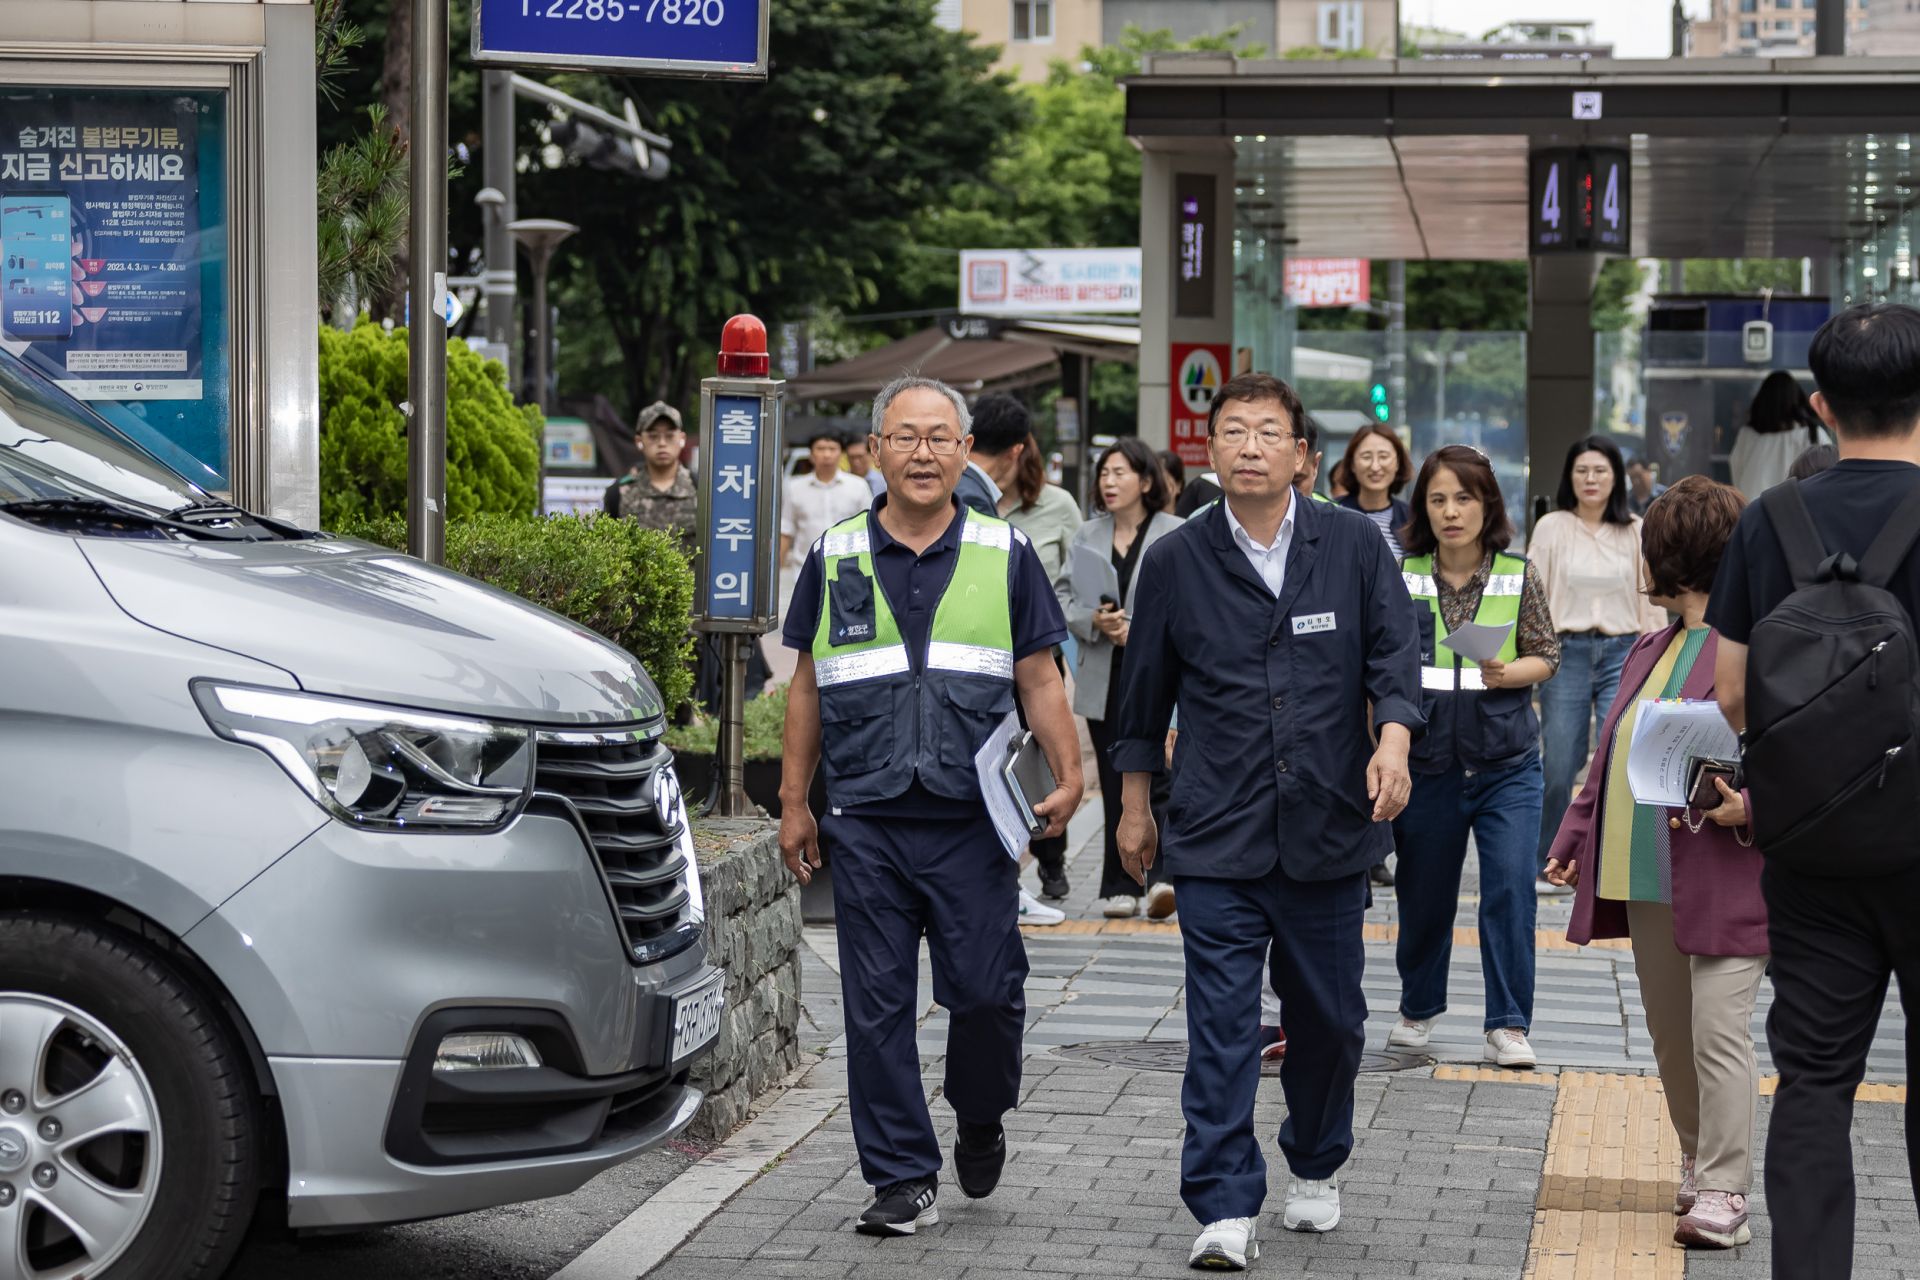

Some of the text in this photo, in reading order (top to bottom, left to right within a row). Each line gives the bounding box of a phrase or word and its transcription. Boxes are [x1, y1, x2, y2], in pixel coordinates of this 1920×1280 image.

[18, 126, 185, 150] 숨겨진 불법무기류,
[1, 153, 185, 181] 지금 신고하세요
[1541, 162, 1561, 229] 4
[1602, 162, 1620, 229] 4
[37, 310, 60, 324] 112
[713, 409, 756, 606] 출차주의
